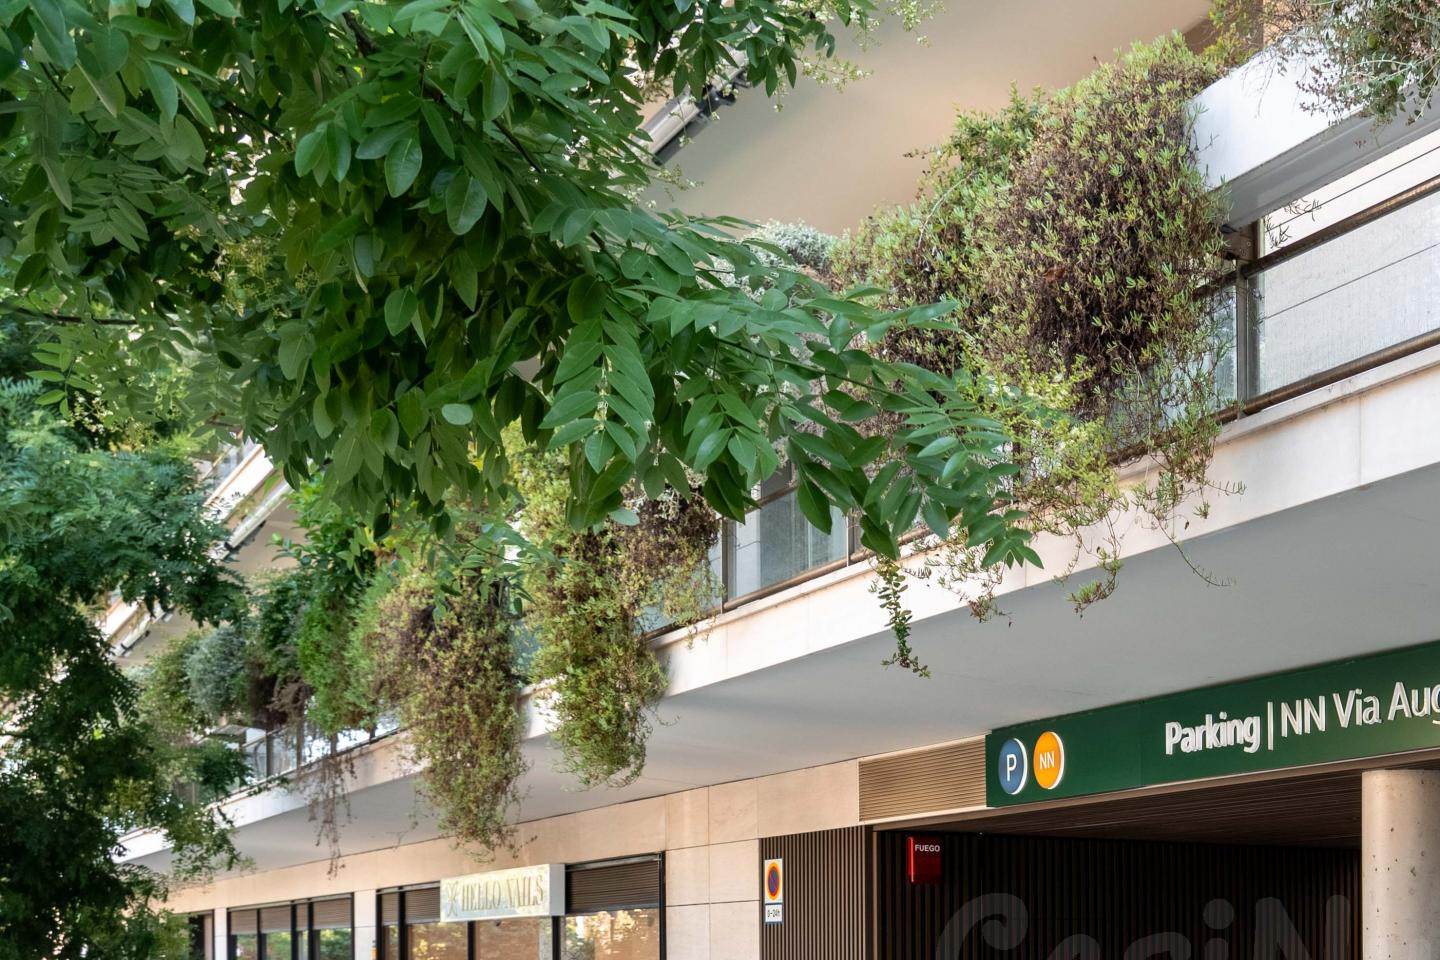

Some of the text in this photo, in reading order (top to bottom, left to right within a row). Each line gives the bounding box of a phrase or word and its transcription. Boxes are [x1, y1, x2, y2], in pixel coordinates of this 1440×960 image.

[1165, 711, 1261, 755] Parking
[1281, 695, 1326, 737] NN
[1332, 687, 1382, 728] Via
[1006, 753, 1017, 782] P
[1039, 751, 1055, 770] NN
[914, 844, 941, 852] FUEGO
[462, 874, 544, 912] HELLO NAILS
